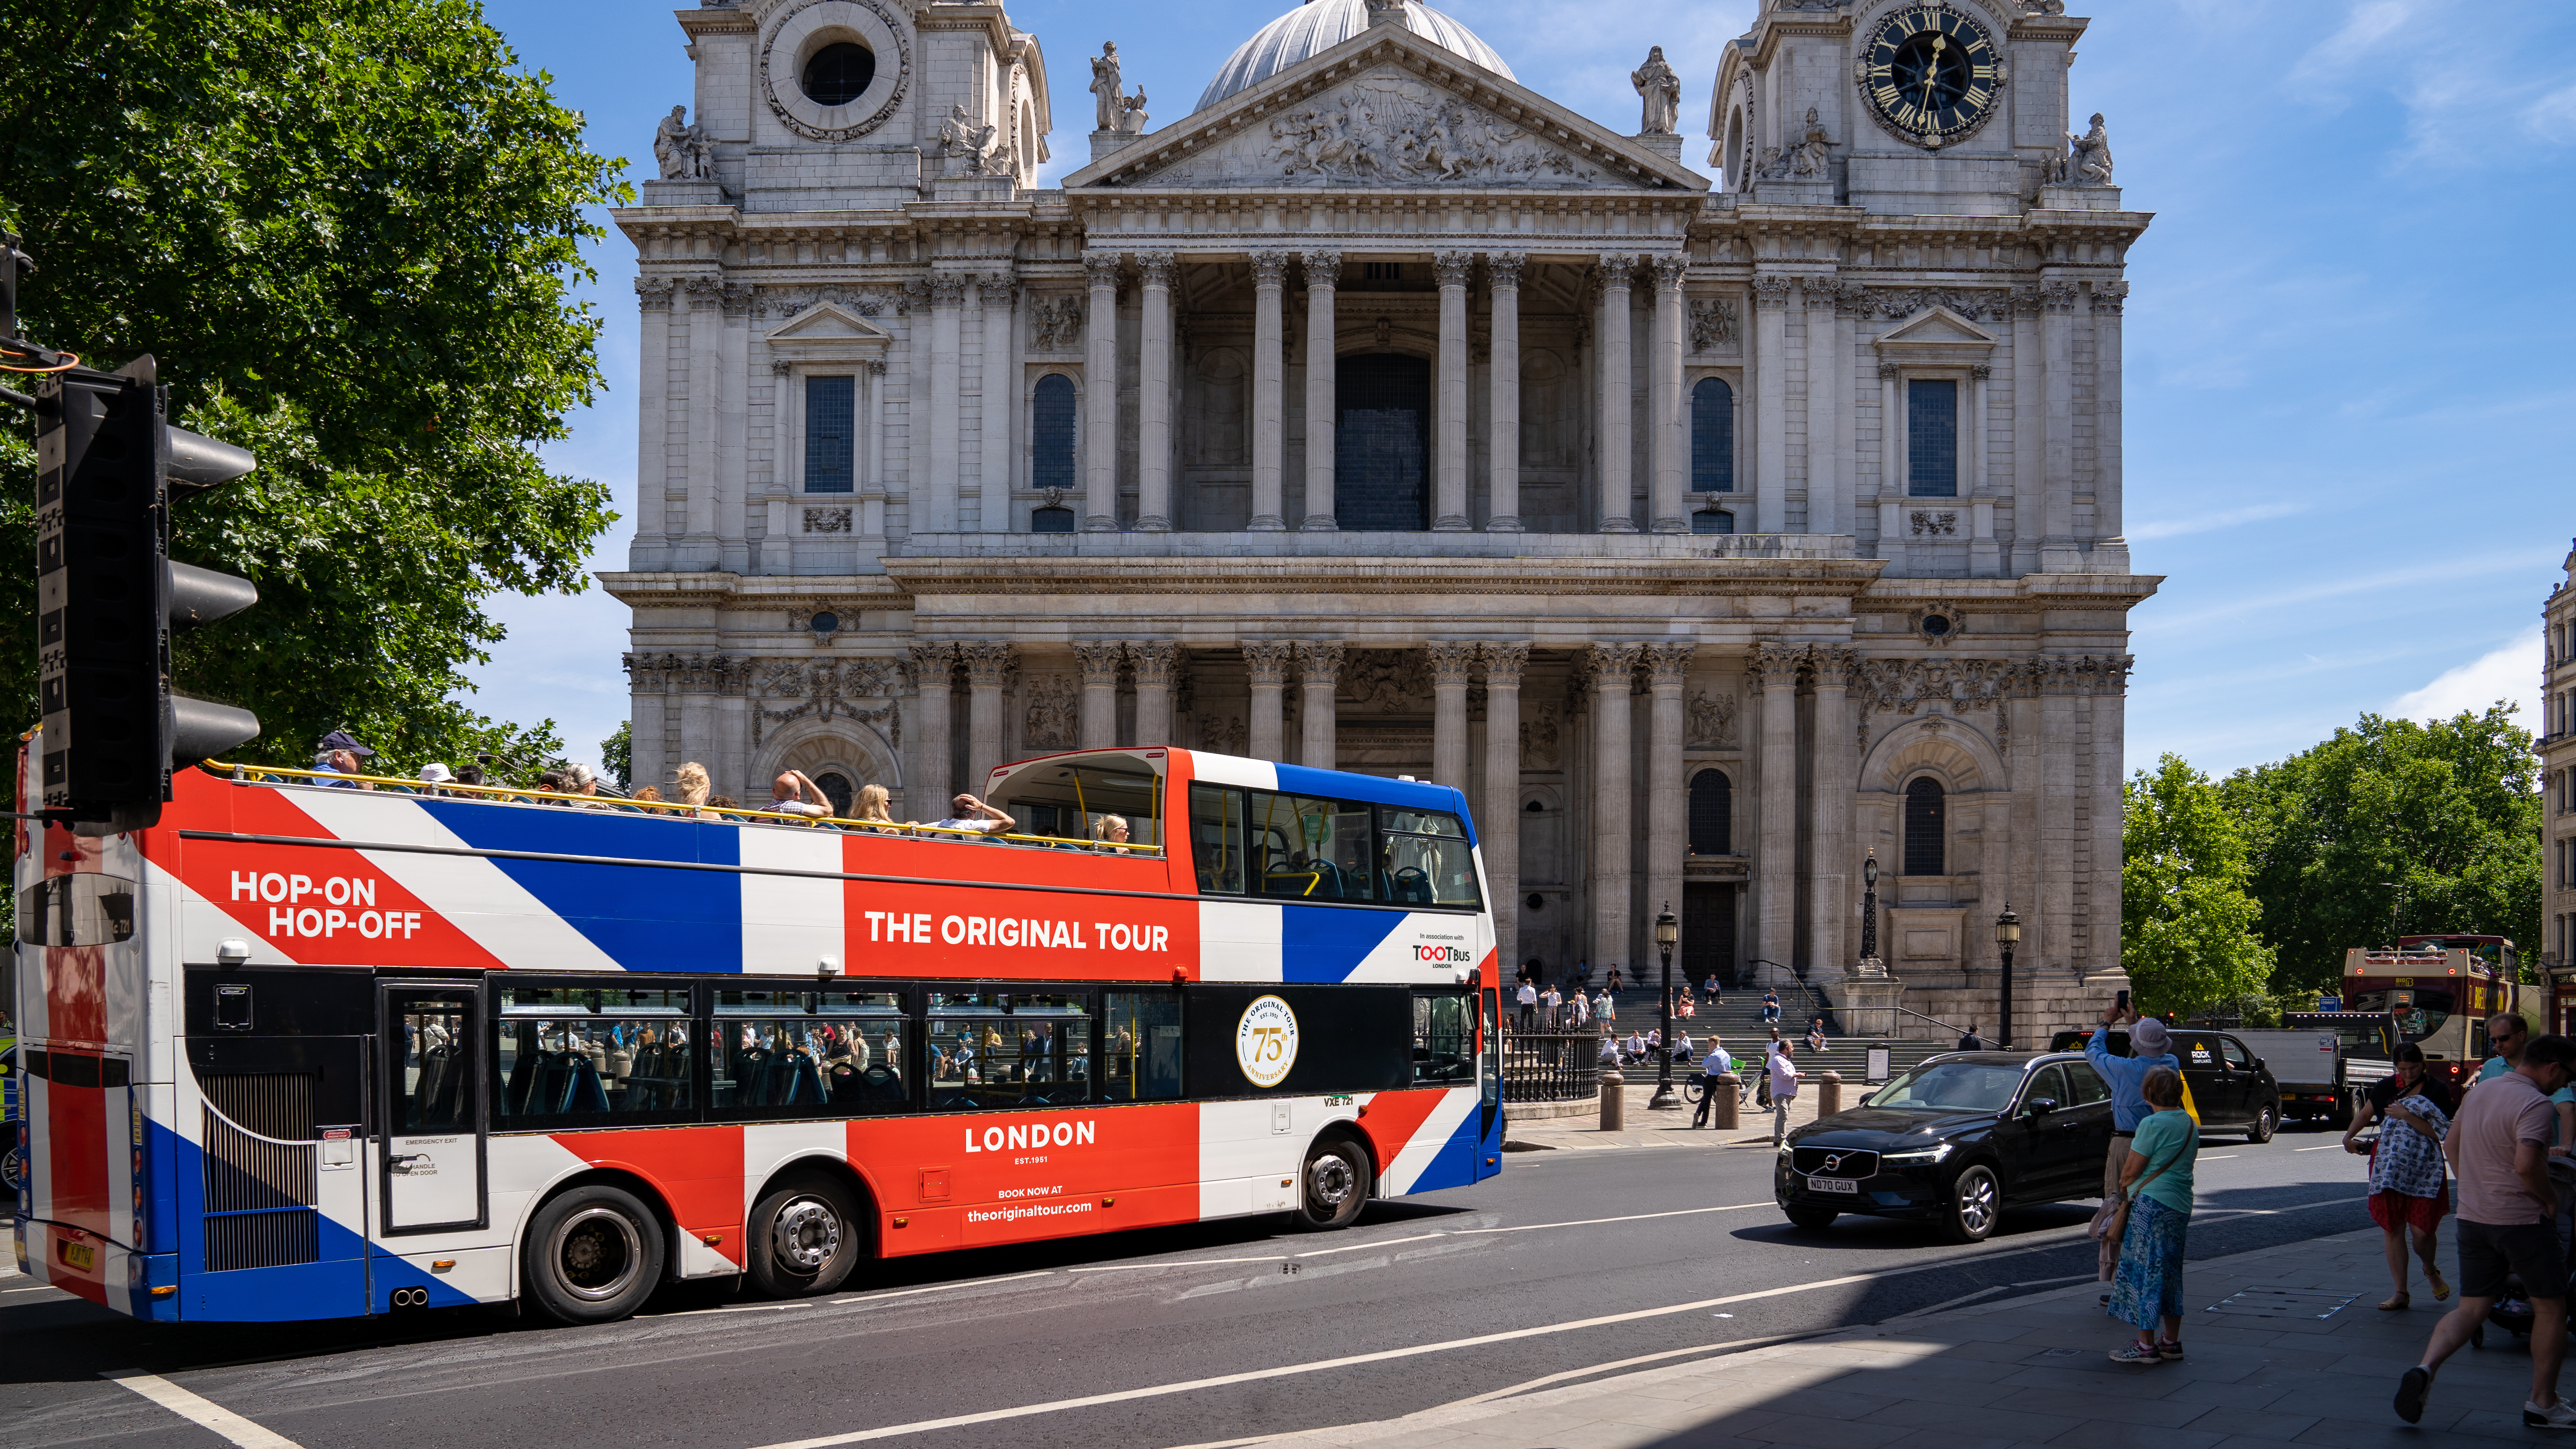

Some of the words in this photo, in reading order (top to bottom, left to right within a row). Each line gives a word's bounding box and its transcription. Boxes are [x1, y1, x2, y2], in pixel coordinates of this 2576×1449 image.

[1922, 12, 1941, 31] XII
[1927, 135, 1941, 145] 30
[231, 871, 375, 906] HOP-ON
[269, 907, 421, 939] HOP-OFF
[865, 911, 931, 943] THE
[941, 915, 1087, 949] ORIGINAL
[1095, 923, 1168, 952] TOUR
[1242, 1018, 1251, 1038] THE
[1251, 1002, 1283, 1016] ORIGINAL
[1284, 1011, 1294, 1036] TOUR
[1246, 1060, 1288, 1080] ANNIVERSARY
[1324, 1097, 1339, 1107] VXE
[1342, 1097, 1353, 1106] 721
[966, 1121, 1095, 1152] LONDON
[999, 1189, 1025, 1198] BOOK
[1027, 1187, 1049, 1196] NOW
[1051, 1185, 1062, 1194] AT
[1810, 1179, 1833, 1190] ND70
[1835, 1181, 1853, 1191] GUX
[968, 1203, 1092, 1222] theoriginaltour.com
